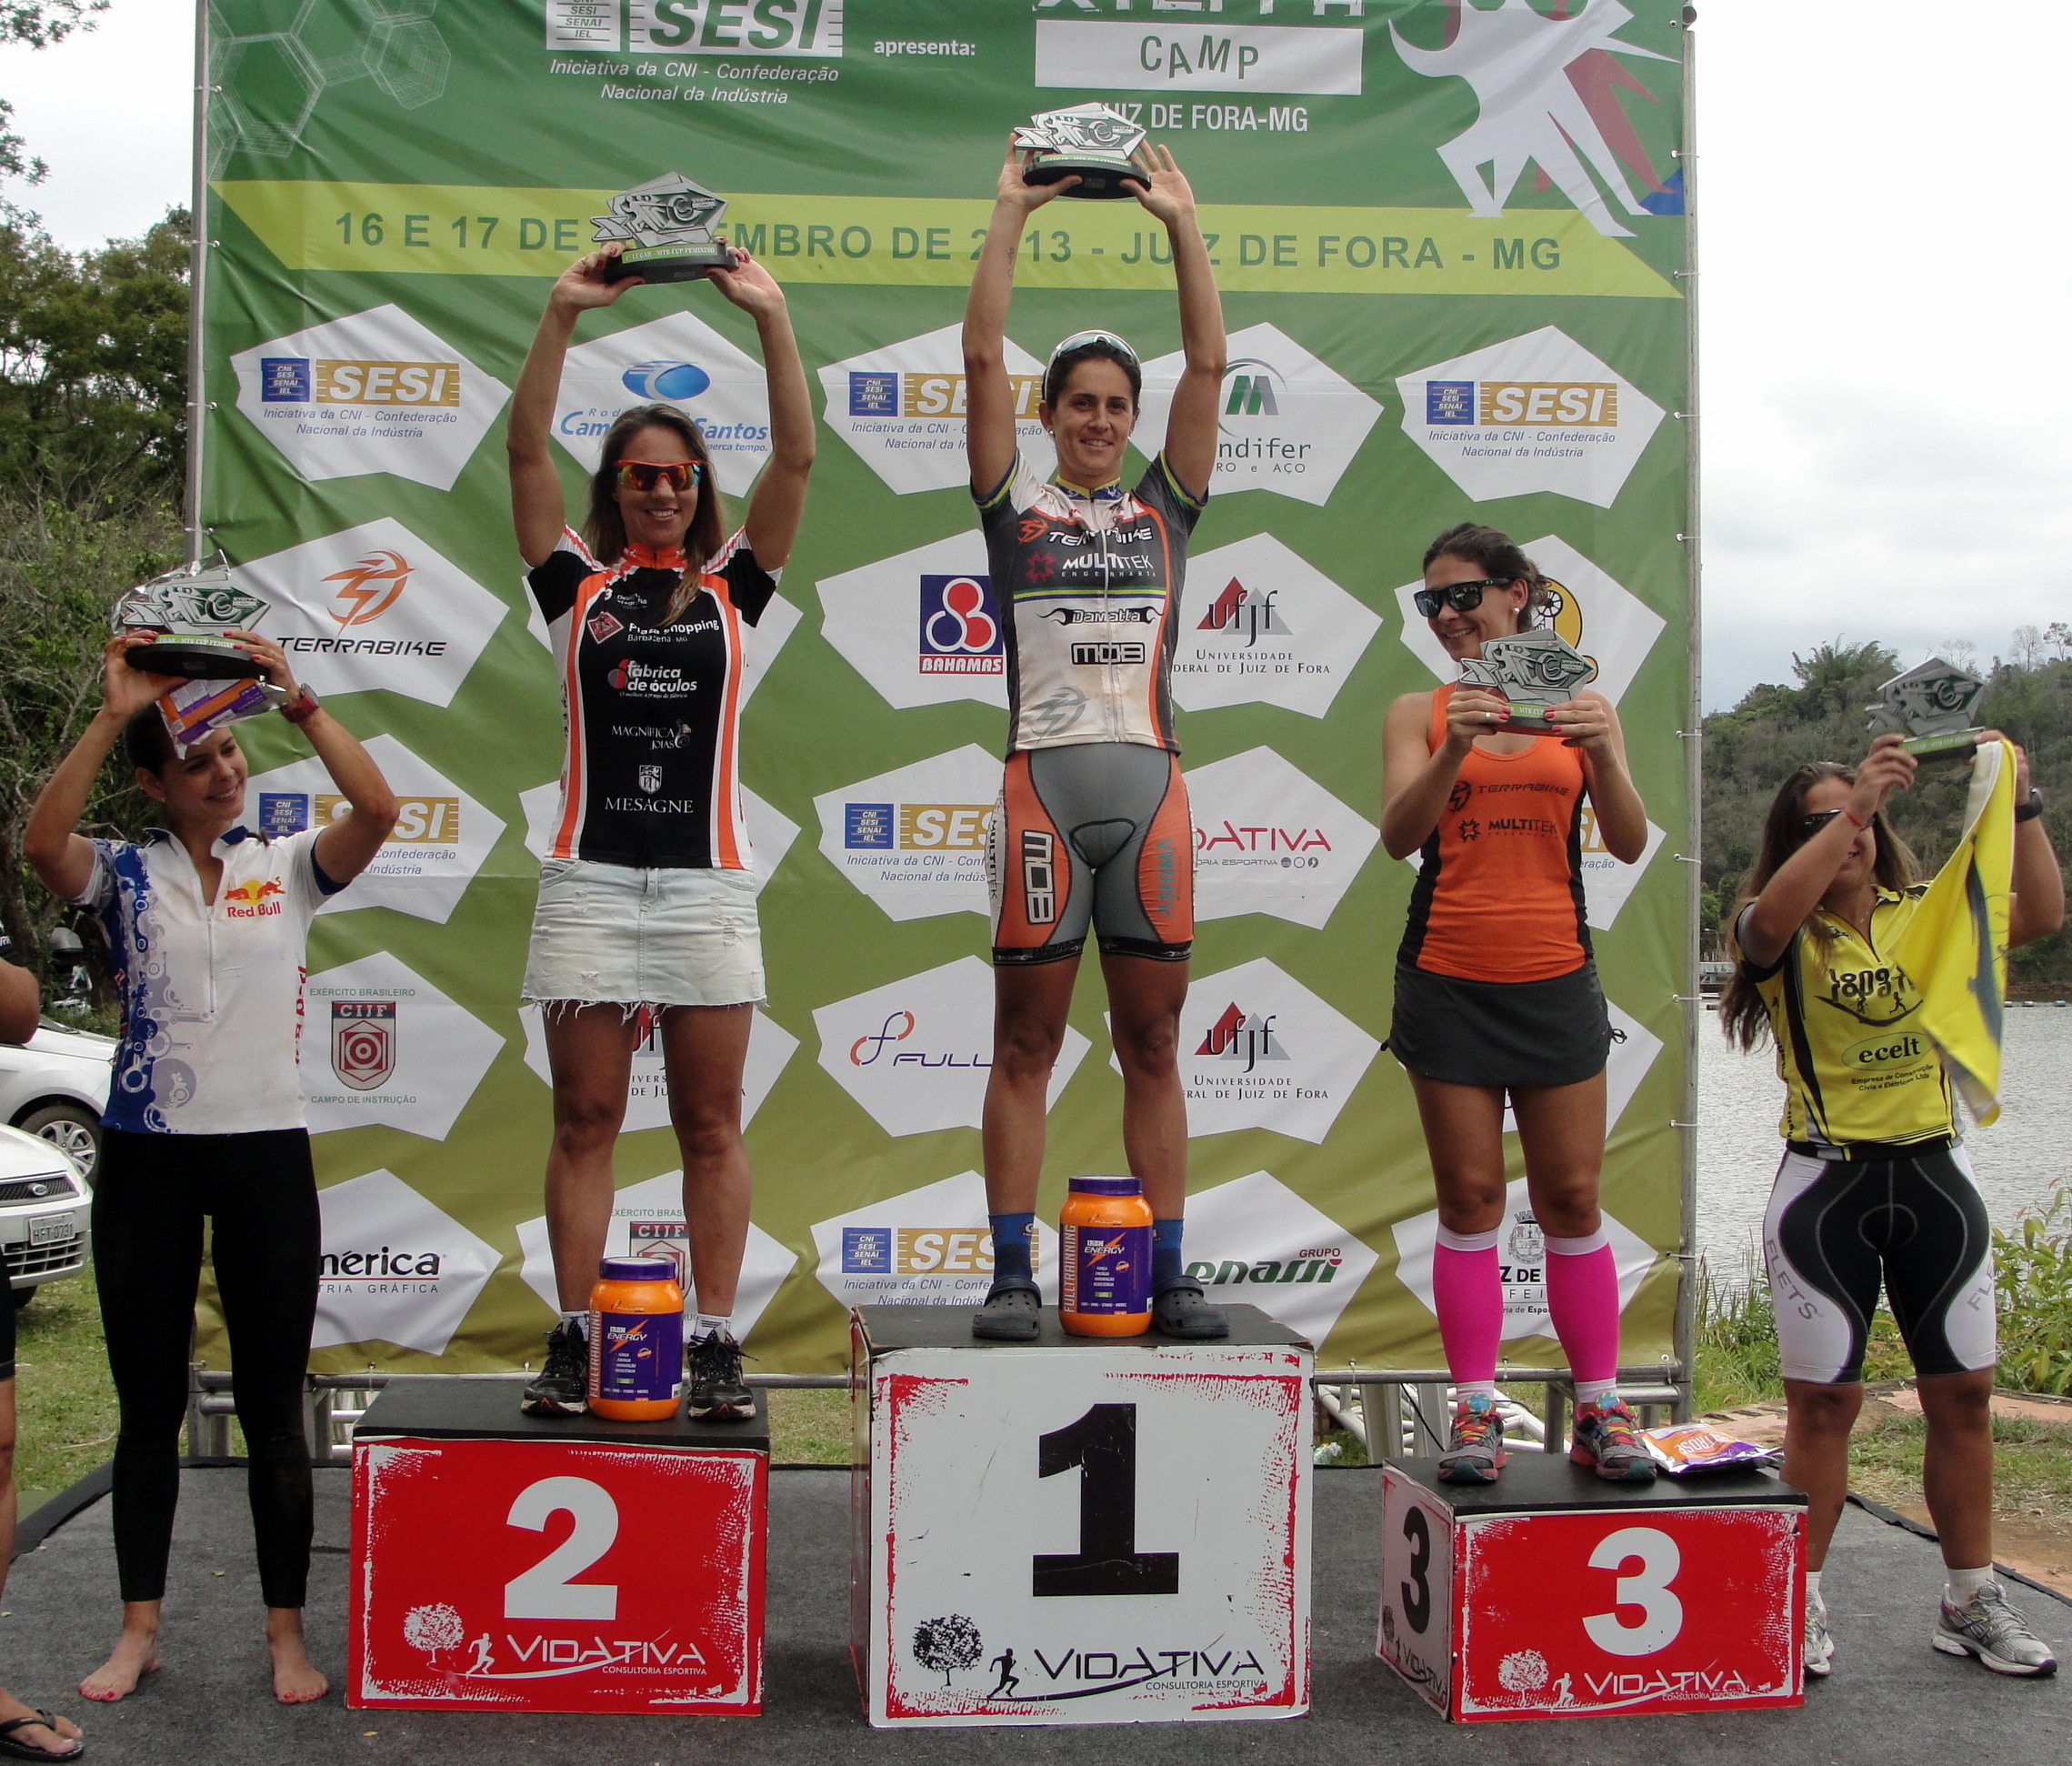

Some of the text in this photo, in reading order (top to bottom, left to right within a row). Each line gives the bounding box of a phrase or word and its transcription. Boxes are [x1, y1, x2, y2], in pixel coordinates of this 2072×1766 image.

[571, 5, 596, 15] SESI
[566, 18, 602, 28] SENAI
[649, 0, 824, 50] SESI
[575, 30, 592, 39] IEL
[874, 39, 976, 56] apresenta:
[1140, 35, 1259, 80] CAMP
[550, 59, 839, 84] Iniciativa da CNI Confederação
[601, 84, 788, 105] Nacional da Indústria
[1151, 104, 1308, 132] DE FORA-MG
[335, 212, 1561, 270] 16 E 17 DE DE 213 JUZ DE FORA MG
[329, 366, 446, 402] SESI
[1492, 387, 1605, 422] SESI
[264, 408, 457, 424] Iniciativa da CNI Confederação
[296, 424, 423, 438] Nacional da Indústria
[851, 422, 948, 434] Iniciativa da CNI
[1428, 430, 1616, 444] Iniciativa da CNI Confederação
[885, 438, 936, 449] Nacional
[940, 439, 954, 450] da
[1219, 438, 1311, 458] ndifer
[1461, 446, 1583, 457] Nacional da Indústria
[1251, 463, 1306, 475] e AÇO
[276, 637, 447, 656] TERRABIKE
[922, 657, 1001, 672] BAHAMAS
[1217, 664, 1232, 673] DE
[1276, 665, 1289, 673] DE
[627, 678, 646, 691] de
[1477, 784, 1569, 797] TERRABIKE
[606, 798, 694, 813] MESAGNE
[1488, 818, 1558, 834] MULTITEK
[374, 848, 455, 861] Confederação
[846, 855, 945, 866] Iniciativa da CNI
[369, 865, 422, 875] Indústria
[881, 871, 949, 882] Nacional da
[227, 902, 282, 918] Red Bull
[310, 987, 415, 997] EXÉRCITO BRASILEIRO
[340, 1004, 387, 1017] CIJF
[1858, 1037, 1920, 1063] ecelt
[631, 1088, 646, 1096] DE
[1216, 1090, 1230, 1099] DE
[1274, 1090, 1287, 1099] DE
[311, 1094, 416, 1105] CAMPO DE INSTRUÇÃO
[638, 1225, 685, 1238] CIJF
[1299, 1248, 1341, 1258] GRUPO
[1516, 1269, 1541, 1282] DE
[367, 1283, 438, 1293] GRÁFICA
[844, 1279, 942, 1289] Iniciativa da CNI
[877, 1295, 946, 1305] Nacional da
[607, 1333, 647, 1341] ENERGY
[1033, 1402, 1179, 1597] 1
[504, 1475, 619, 1621] 2
[1401, 1506, 1430, 1634] 3
[1582, 1527, 1683, 1657] 3
[506, 1634, 706, 1665] VIDATIVA
[1034, 1647, 1265, 1680] VIDATIVA
[602, 1666, 707, 1676] CONSULTORIA ESPORTIVA
[1146, 1680, 1266, 1691] CONSULTORIA ESPORTIVA
[1584, 1670, 1747, 1696] VIDATIVA
[1662, 1691, 1710, 1701] CONSULTORIA
